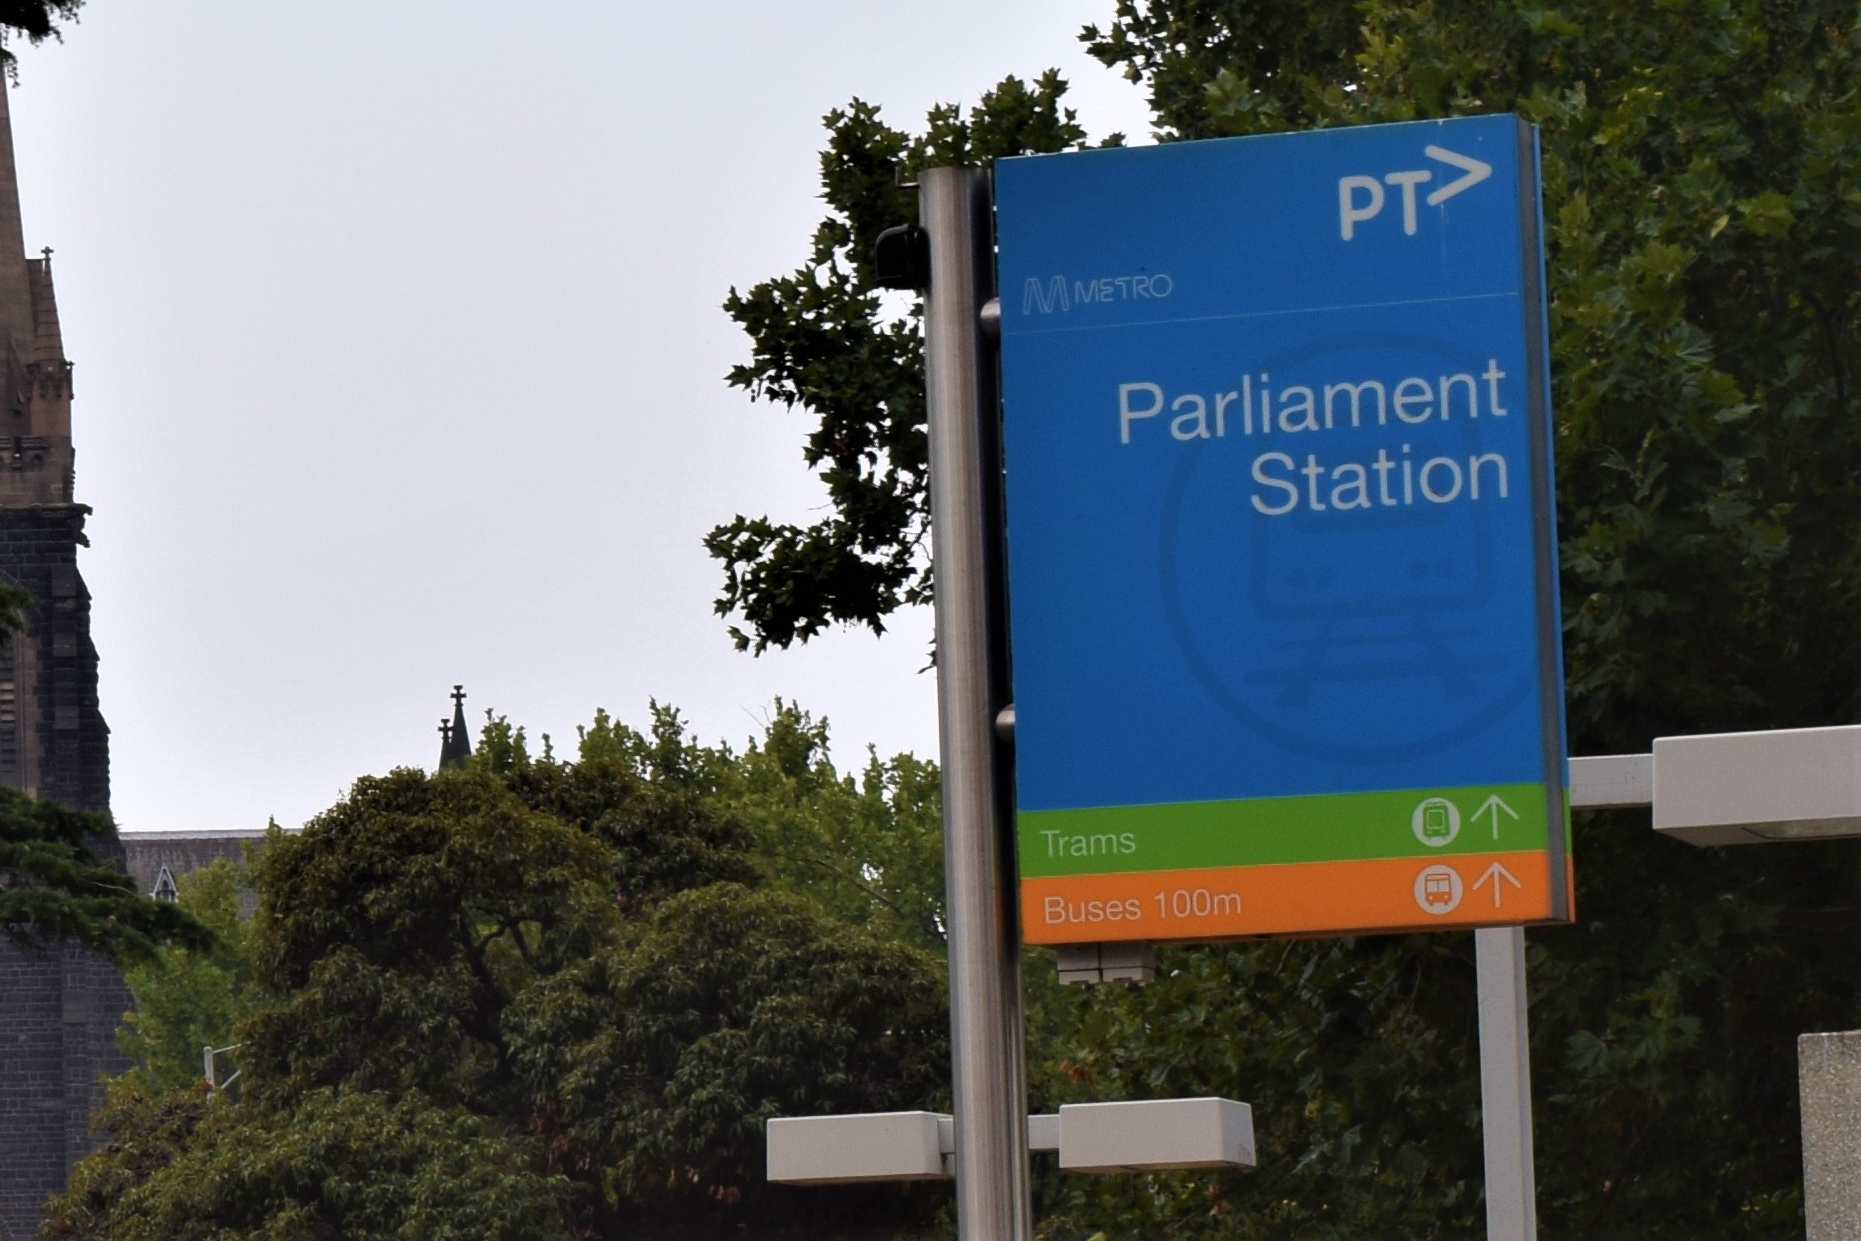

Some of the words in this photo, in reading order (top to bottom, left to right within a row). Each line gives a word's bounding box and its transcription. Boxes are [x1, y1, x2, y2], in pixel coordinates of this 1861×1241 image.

[1075, 263, 1173, 304] METRO
[1117, 358, 1508, 445] Parliament
[1249, 442, 1509, 517] Station
[1039, 829, 1137, 858] Trams
[1043, 895, 1142, 925] Buses
[1153, 888, 1242, 919] 100m
